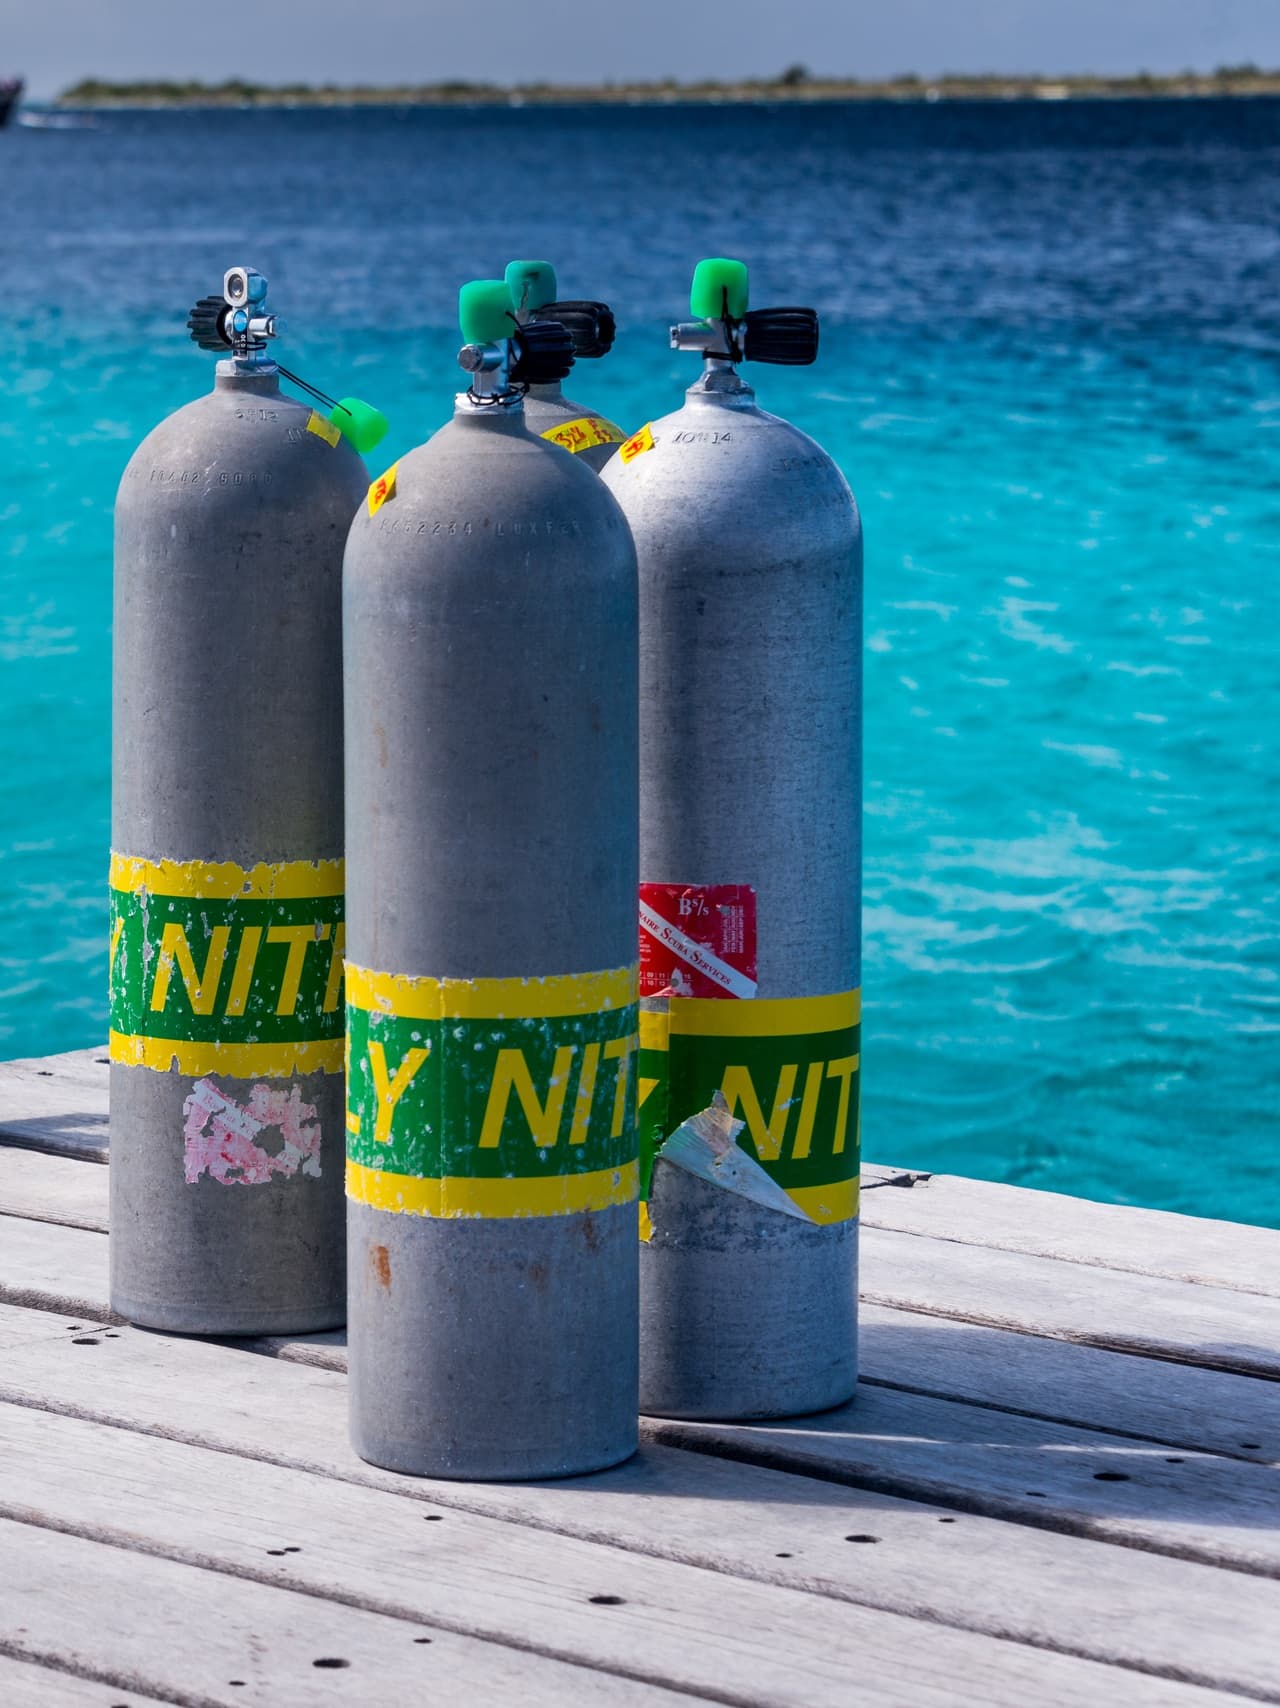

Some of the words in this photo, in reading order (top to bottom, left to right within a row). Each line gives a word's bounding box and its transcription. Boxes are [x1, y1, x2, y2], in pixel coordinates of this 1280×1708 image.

[660, 927, 689, 956] SCUBA
[690, 950, 732, 985] SERVICES
[478, 1032, 639, 1149] NIT
[720, 1053, 860, 1162] NIT
